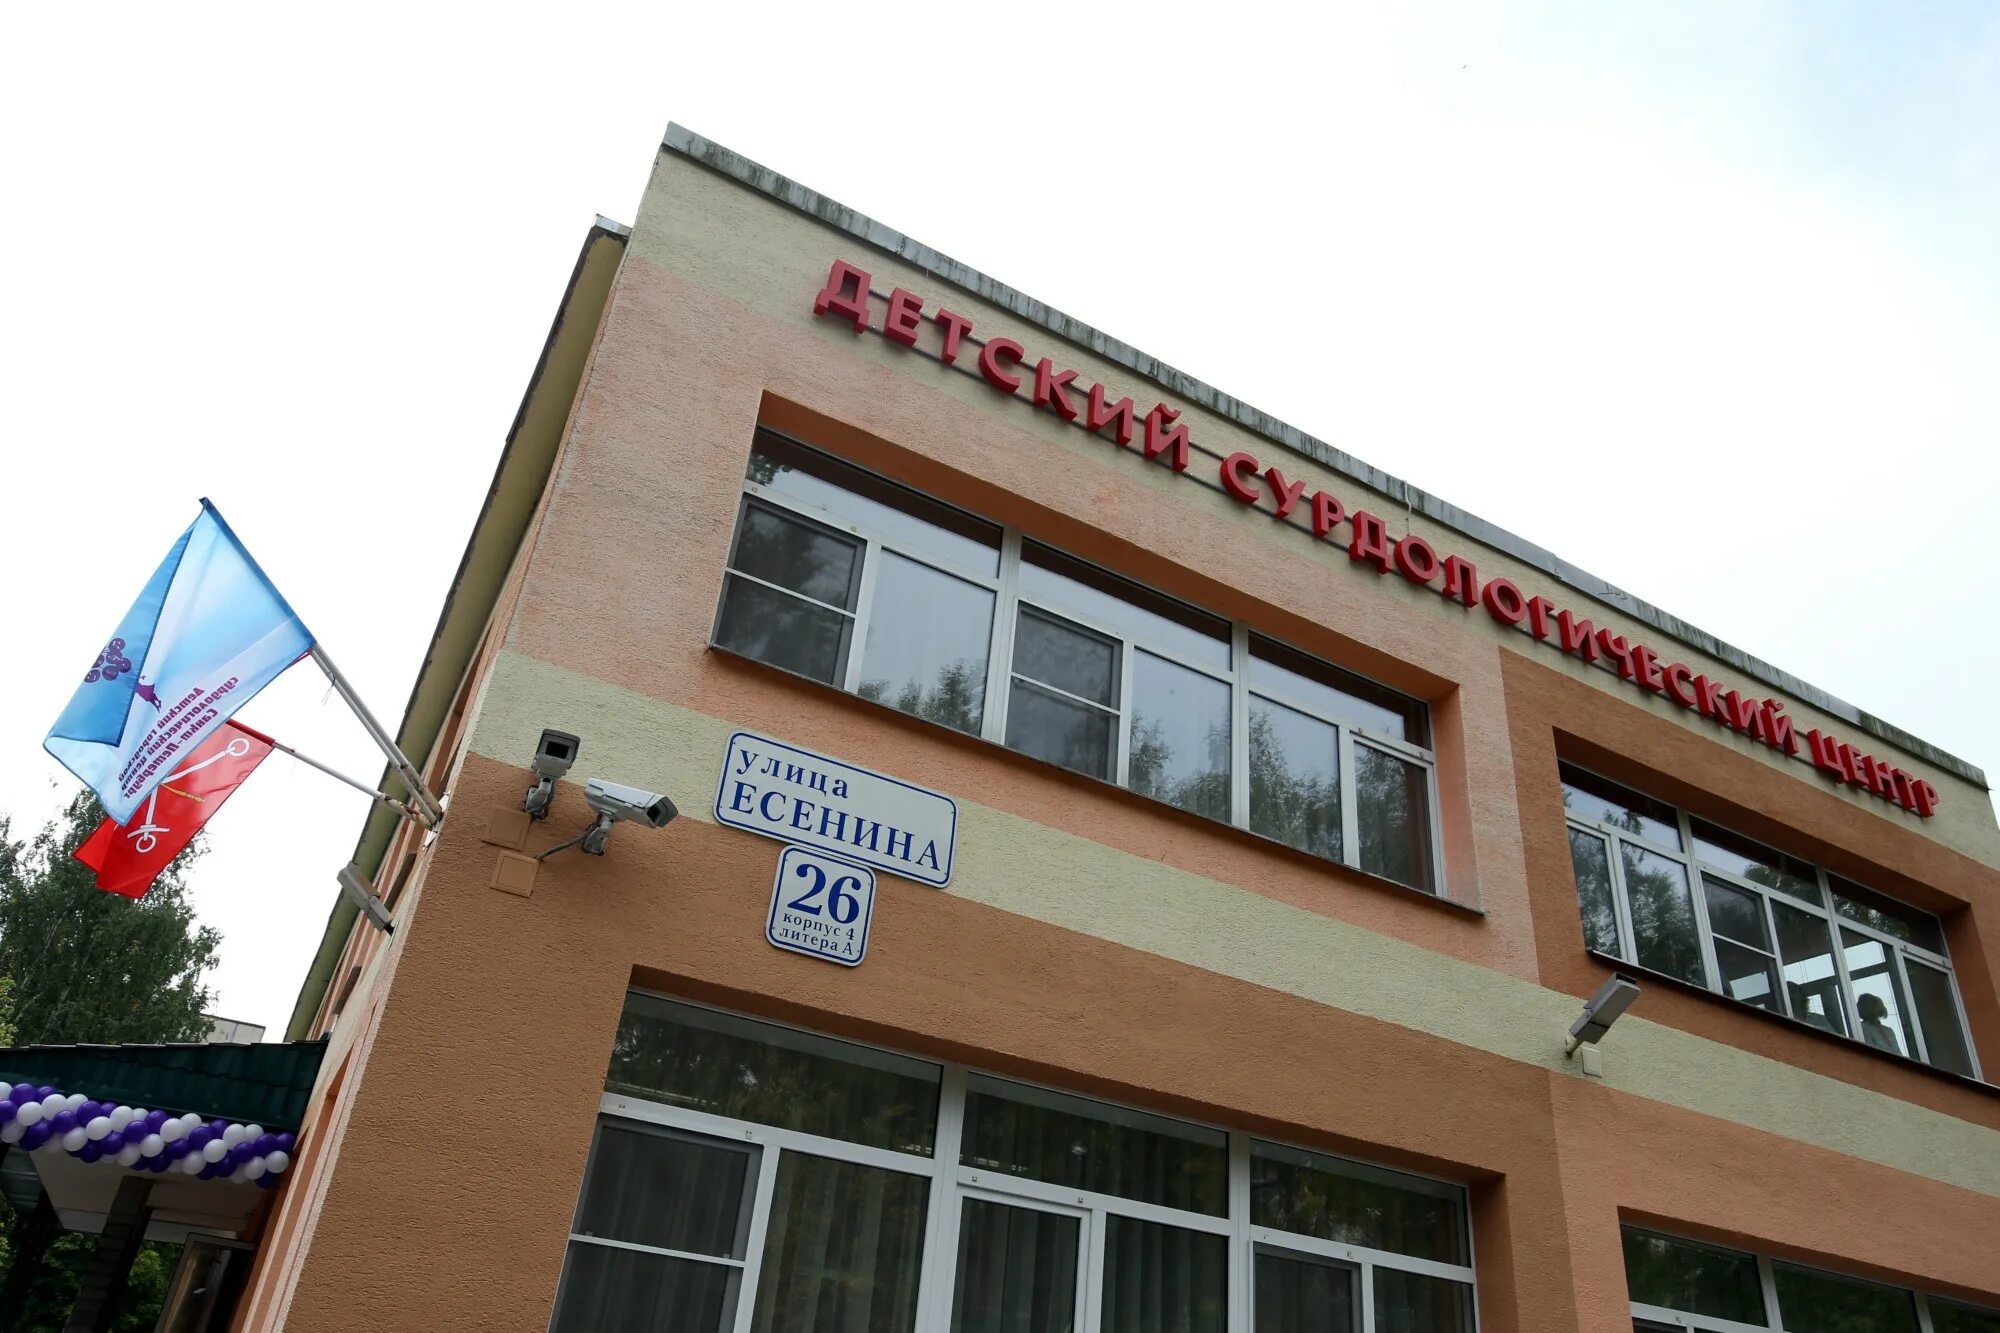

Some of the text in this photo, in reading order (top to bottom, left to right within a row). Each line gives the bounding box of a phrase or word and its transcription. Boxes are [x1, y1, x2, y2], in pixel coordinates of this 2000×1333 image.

[813, 258, 1940, 818] ДЕТСКИЙ СУРДОЛОГИЧЕСКИЙ ЦЕНТР
[736, 749, 848, 799] улица
[729, 780, 941, 871] ЕСЕНИНА
[786, 863, 862, 924] 26
[779, 926, 854, 956] литера А
[783, 912, 856, 941] корпус 4
